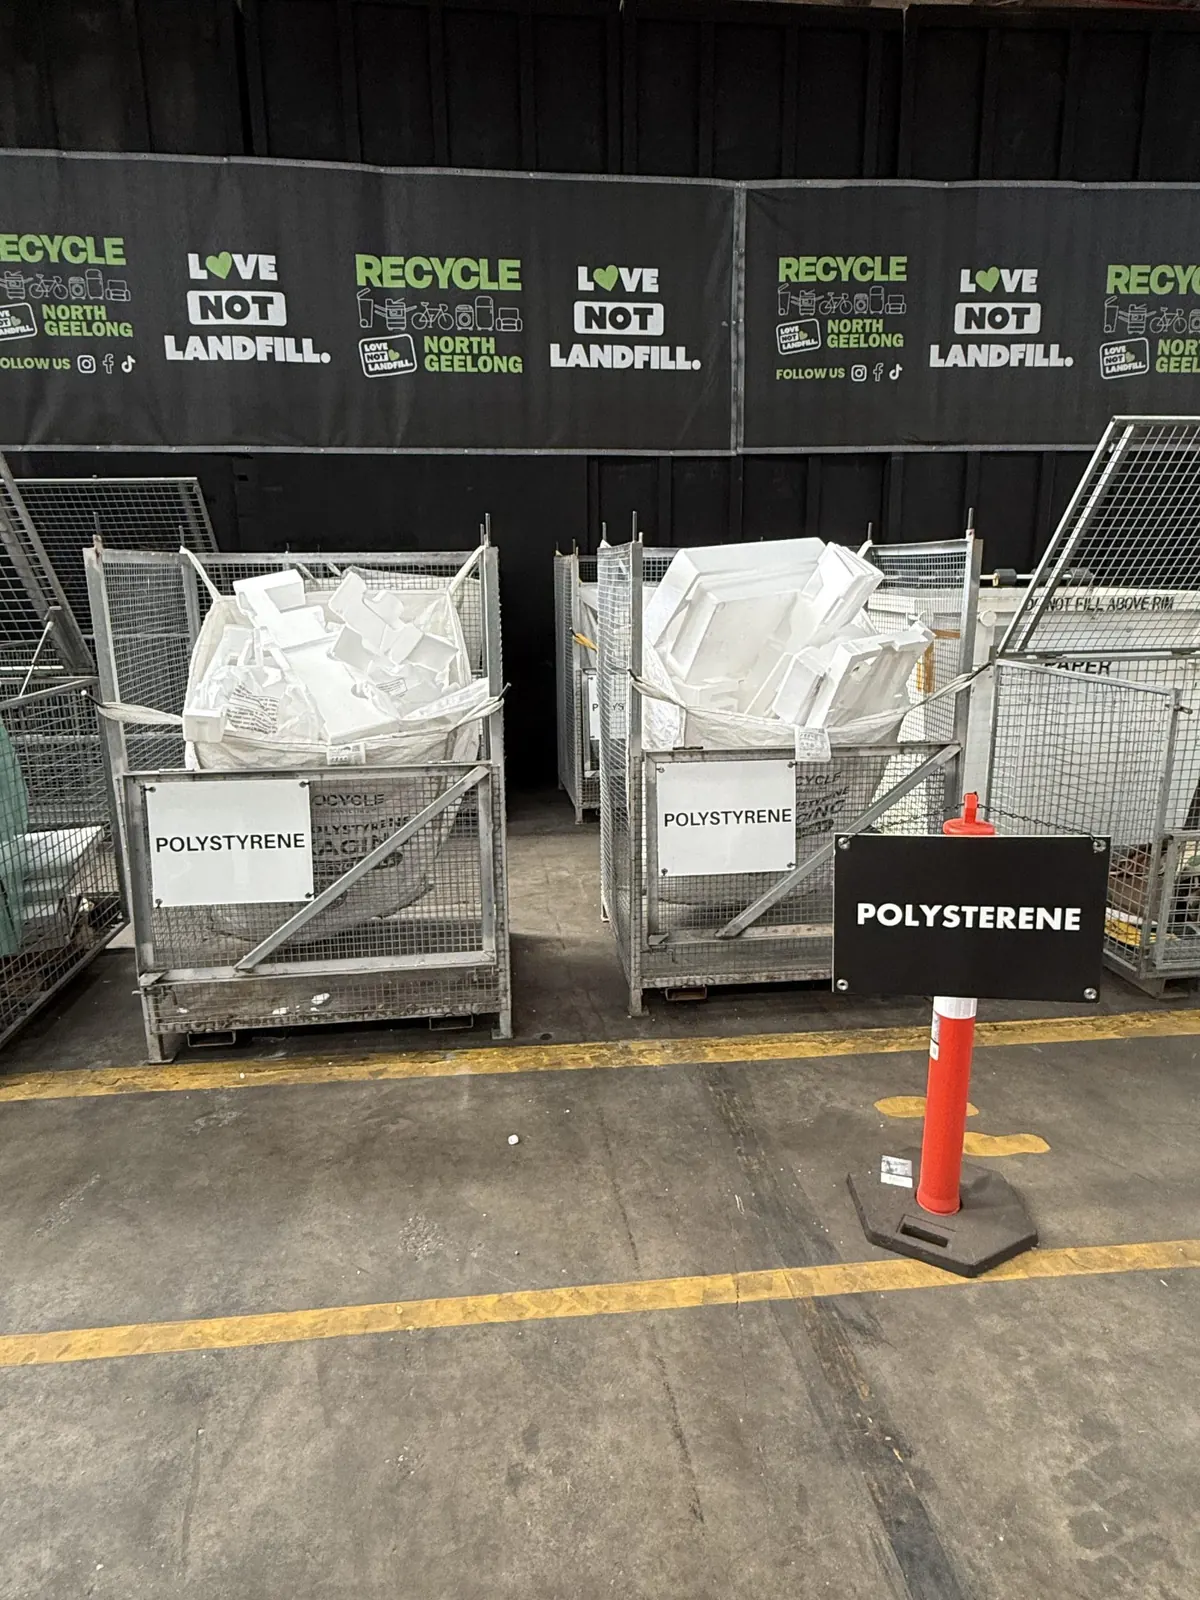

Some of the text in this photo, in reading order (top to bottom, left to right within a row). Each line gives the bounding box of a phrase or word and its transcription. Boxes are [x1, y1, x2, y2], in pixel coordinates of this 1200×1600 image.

[0, 234, 126, 265] ECYCLE
[355, 254, 522, 291] RECYCLE
[779, 256, 907, 282] RECYCLE
[42, 304, 107, 320] NORTH
[199, 295, 274, 320] NOT
[585, 306, 653, 330] NOT
[827, 319, 883, 333] NORTH
[964, 307, 1031, 329] NOT
[44, 321, 133, 337] GEELONG
[780, 325, 799, 334] LOVE
[164, 335, 331, 363] LANDFILL.
[364, 342, 388, 352] LOVE
[424, 336, 495, 354] NORTH
[827, 334, 904, 348] GEELONG
[1104, 345, 1126, 355] LOVE
[1157, 339, 1200, 356] NOR
[52, 358, 71, 370] US
[366, 353, 385, 361] NOT
[424, 355, 523, 373] GEELONG
[550, 343, 701, 370] LANDFILL.
[929, 344, 1074, 367] LANDFILL.
[1106, 356, 1124, 364] NOT
[776, 368, 845, 380] FOLLOW US
[1075, 595, 1103, 612] FILL
[1106, 595, 1150, 611] ABOVE
[664, 809, 792, 827] POLYSTYRENE
[156, 833, 305, 852] POLYSTYRENE
[857, 903, 1081, 931] POLYSTERENE
